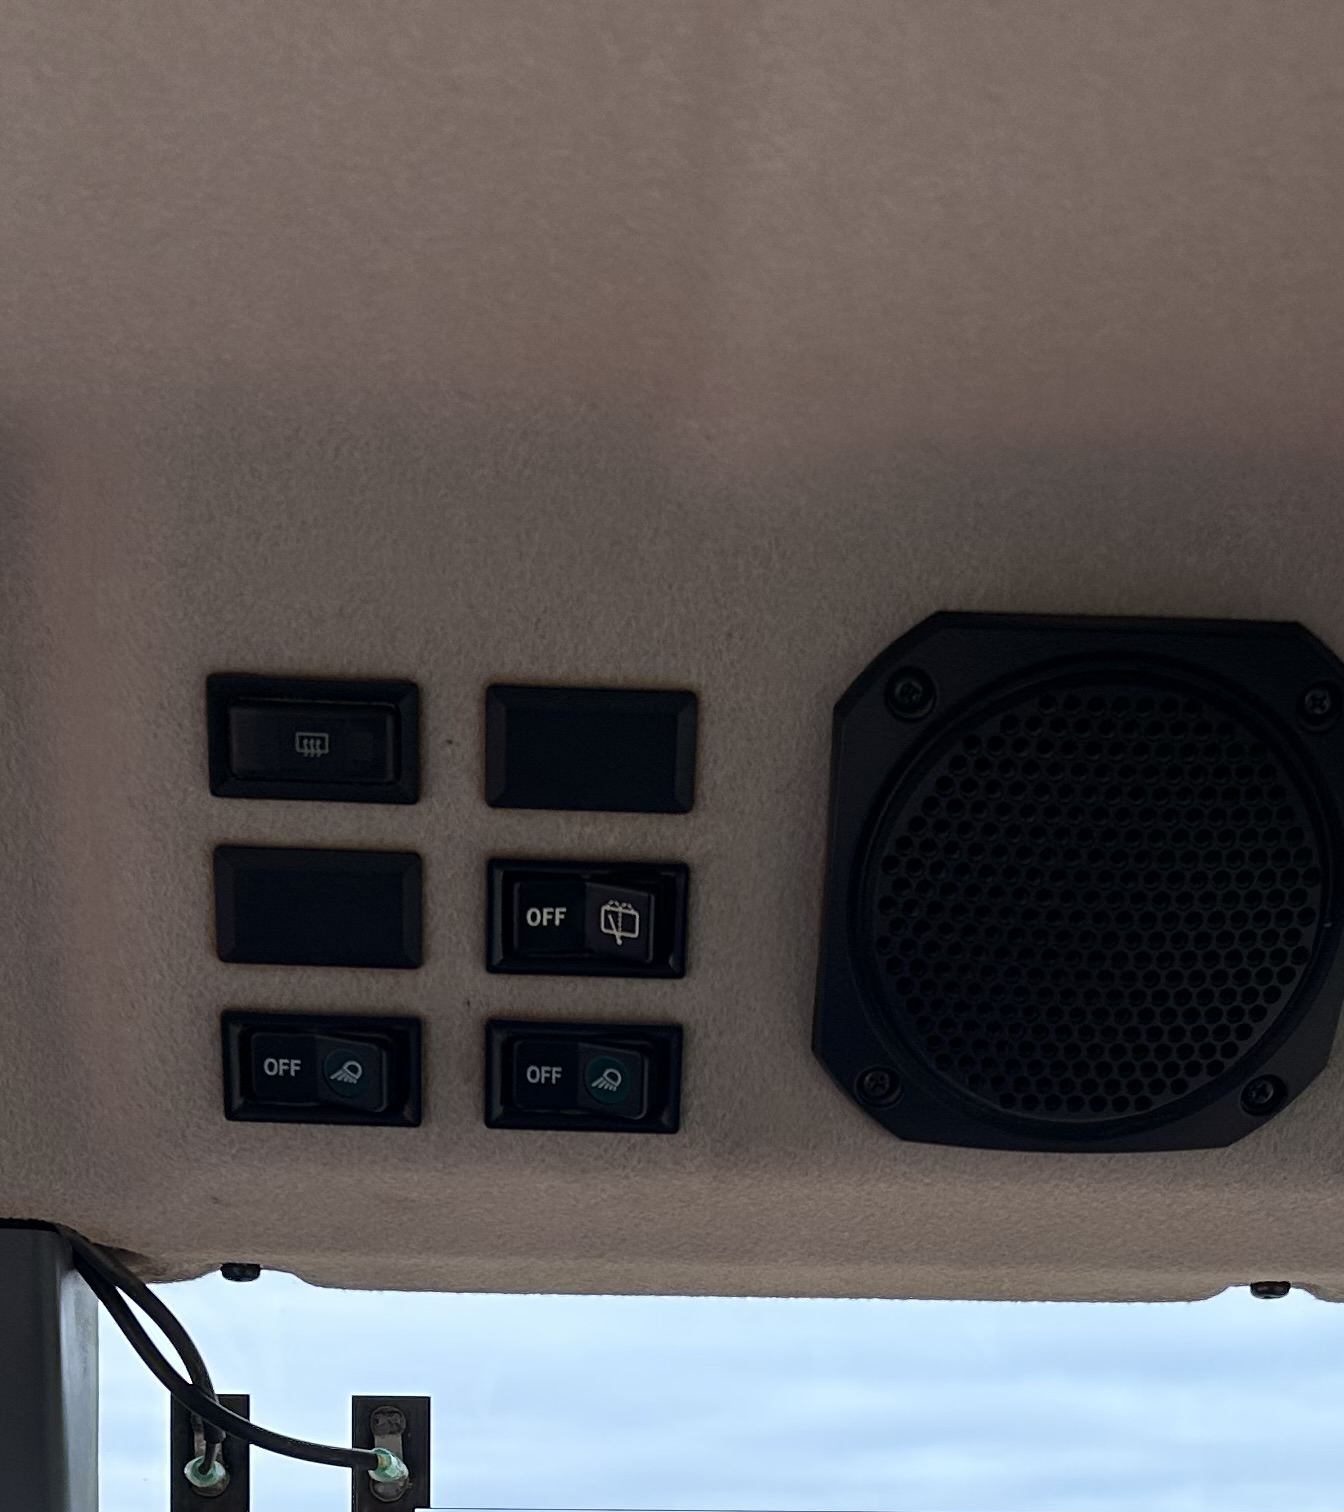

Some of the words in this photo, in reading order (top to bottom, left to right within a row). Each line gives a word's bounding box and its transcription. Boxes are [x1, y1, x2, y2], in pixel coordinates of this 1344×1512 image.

[526, 906, 568, 927] OFF
[263, 1056, 302, 1077] OFF
[526, 1064, 563, 1085] OFF
